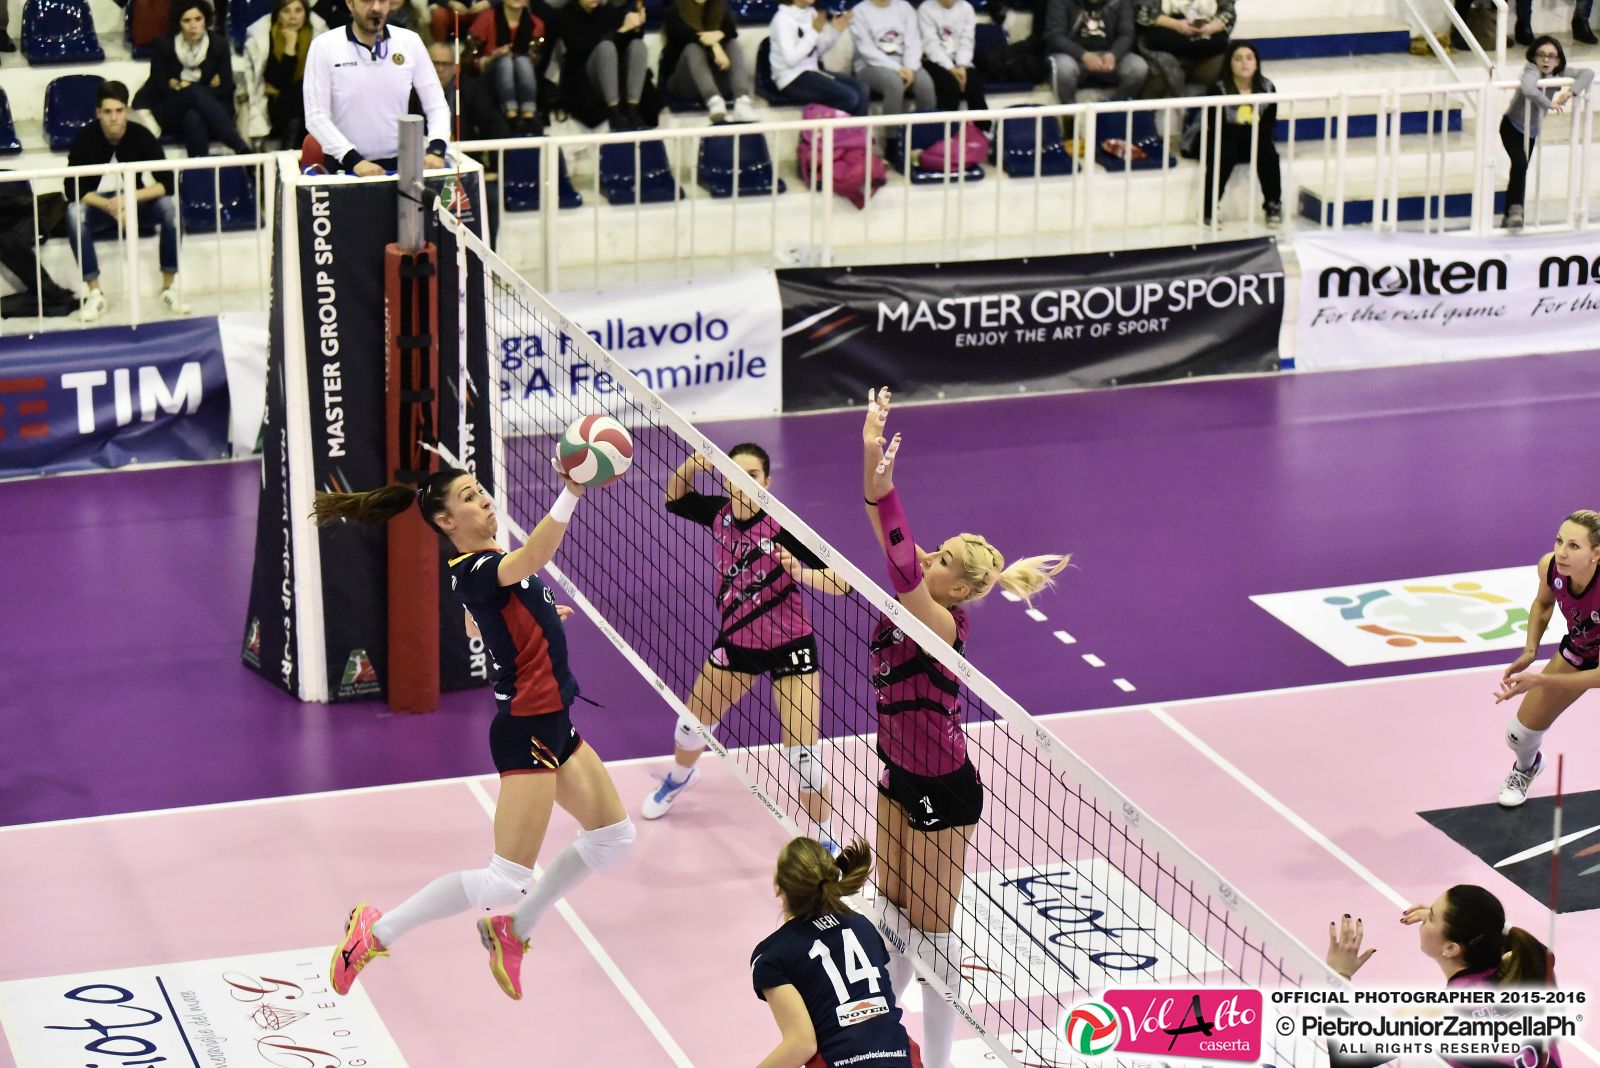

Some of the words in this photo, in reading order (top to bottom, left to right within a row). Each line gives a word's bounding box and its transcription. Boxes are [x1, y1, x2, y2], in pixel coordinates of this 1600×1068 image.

[311, 186, 334, 266] SPORT
[1318, 257, 1507, 299] molten
[317, 270, 340, 358] GROUP
[876, 293, 1024, 333] MASTER
[1030, 282, 1164, 325] GROUP
[1167, 271, 1284, 312] SPORT
[1310, 307, 1343, 328] For
[1350, 303, 1388, 322] the
[1391, 301, 1443, 321] real
[1442, 302, 1508, 326] game
[1532, 297, 1567, 317] For
[954, 331, 1008, 348] ENJOY
[1015, 327, 1046, 344] THE
[1052, 325, 1084, 341] ART
[1089, 323, 1112, 338] OF
[1117, 317, 1171, 336] SPORT
[60, 361, 203, 435] TIM
[322, 361, 346, 458] MASTER
[812, 913, 841, 932] NERI
[877, 919, 906, 954] SAMSUNG
[808, 927, 882, 1005] 14
[838, 1006, 889, 1021] NOVER
